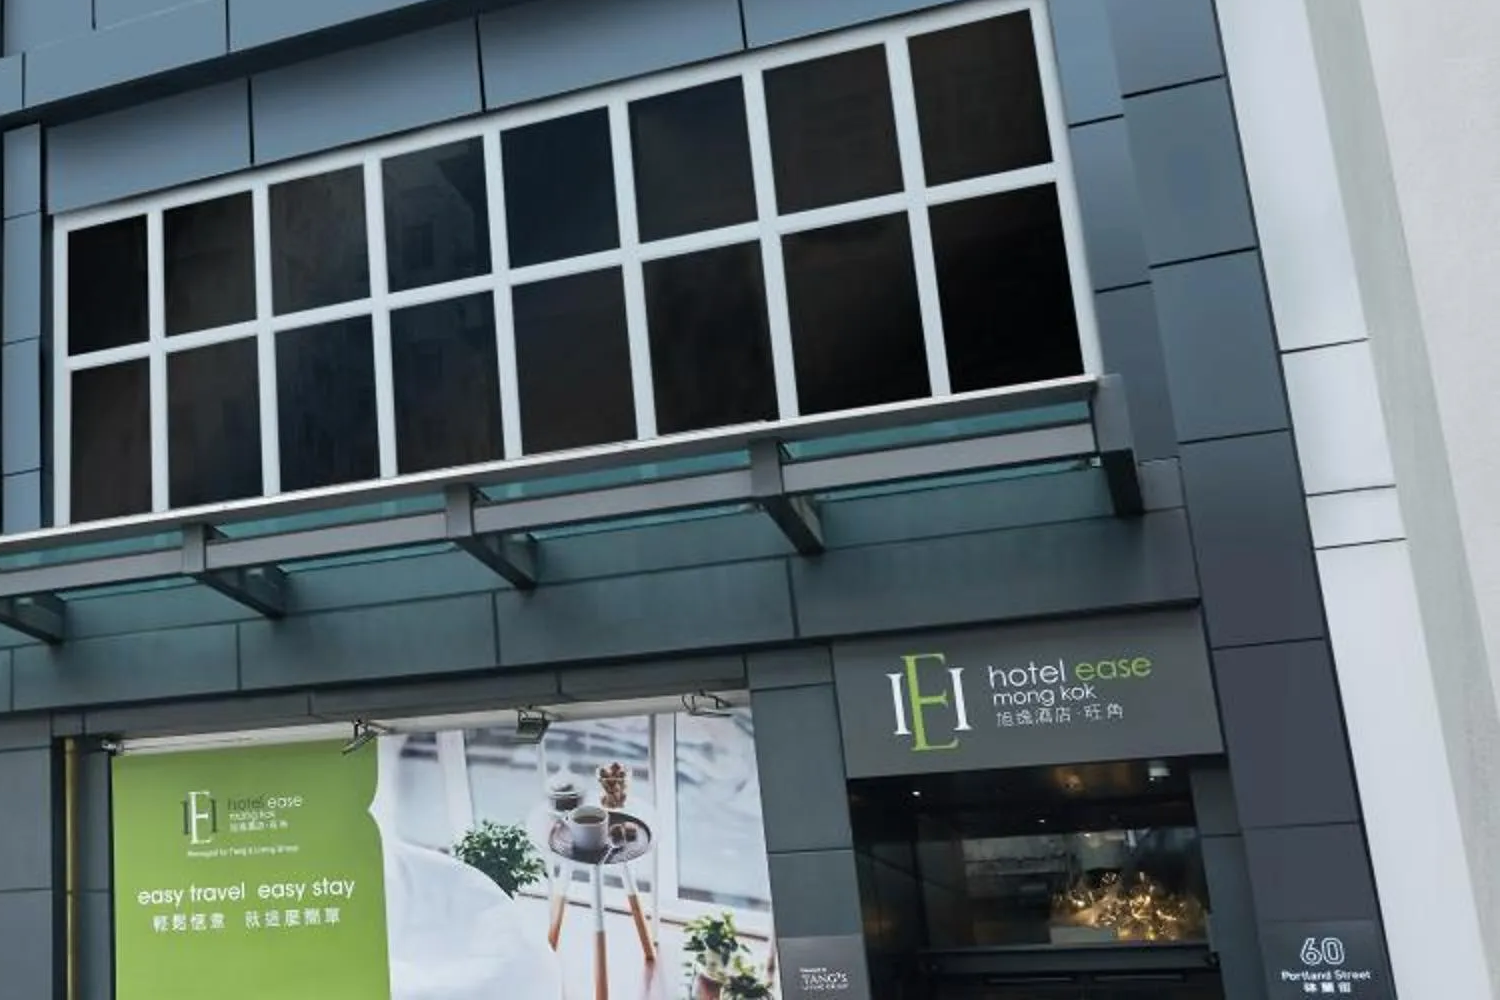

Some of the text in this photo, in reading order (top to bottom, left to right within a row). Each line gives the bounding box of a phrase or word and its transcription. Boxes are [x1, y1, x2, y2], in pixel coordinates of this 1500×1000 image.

[988, 655, 1152, 688] hotel ease
[993, 682, 1097, 707] mong kok
[228, 796, 303, 811] hotel ease
[138, 877, 355, 907] easy travel easy stay
[1300, 937, 1345, 966] 60
[1281, 969, 1371, 981] Portland Street
